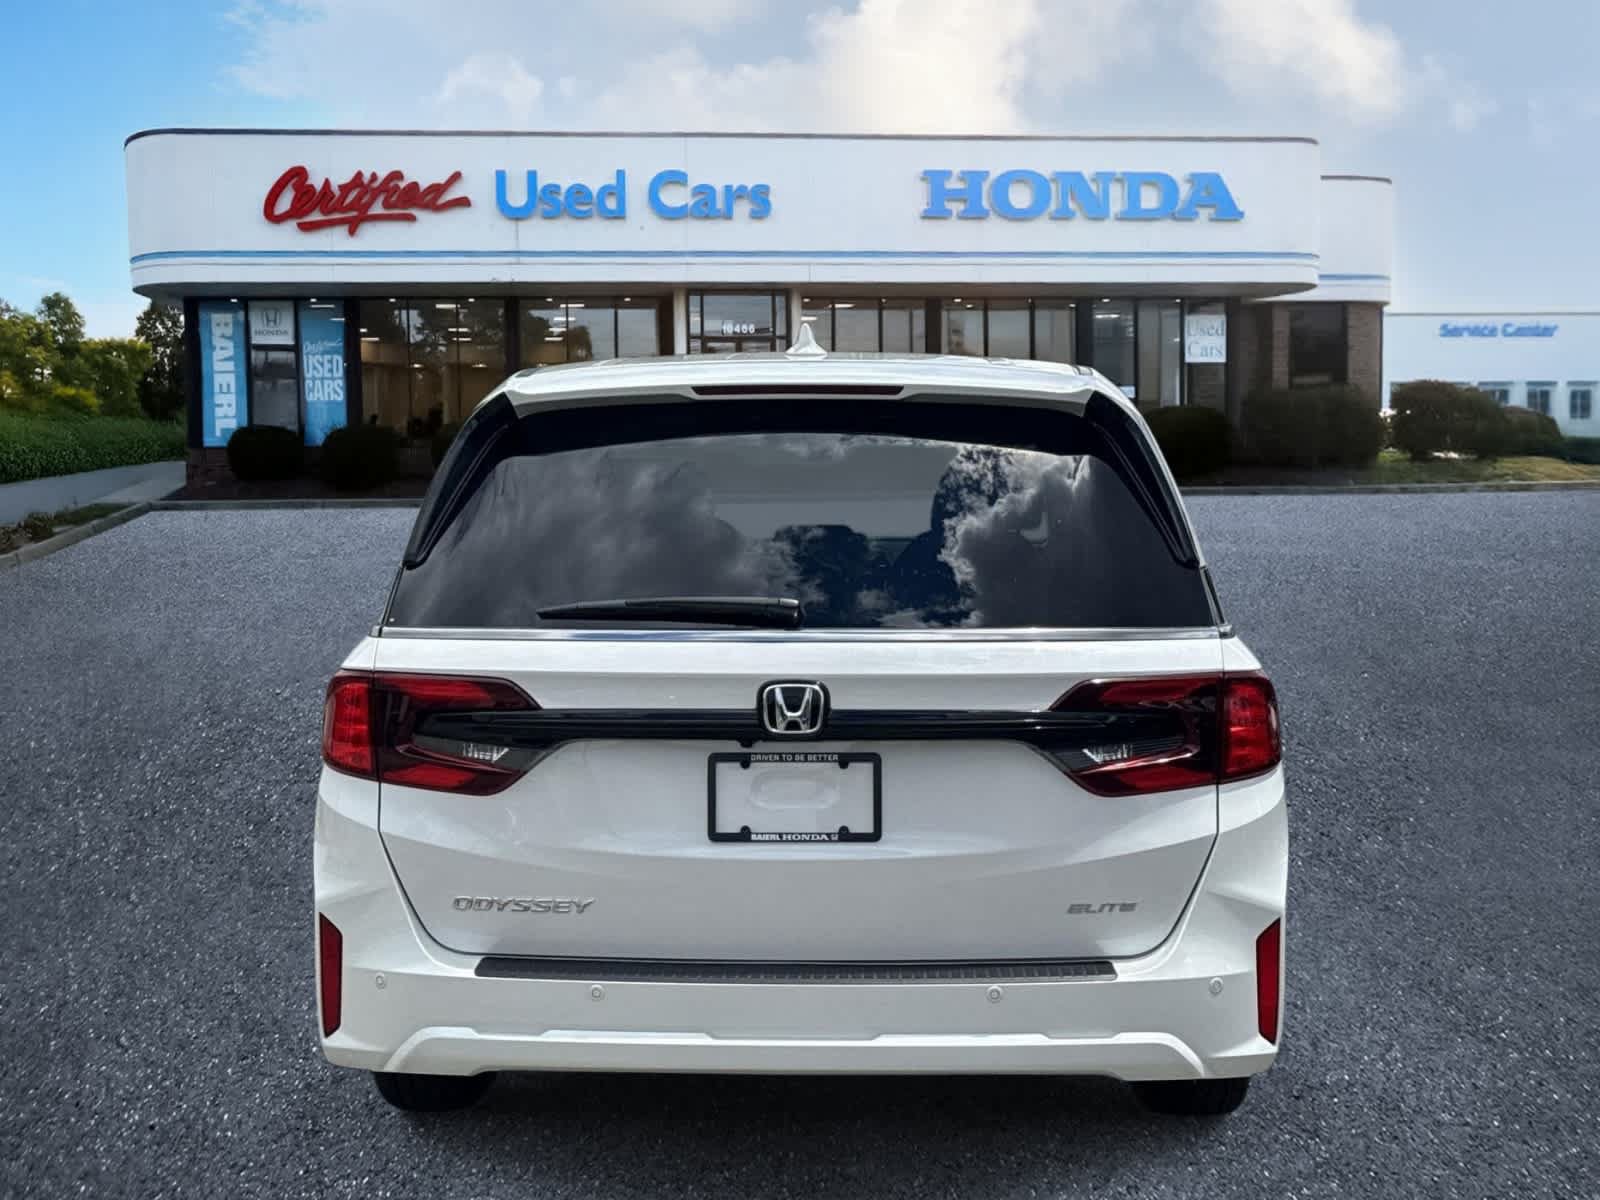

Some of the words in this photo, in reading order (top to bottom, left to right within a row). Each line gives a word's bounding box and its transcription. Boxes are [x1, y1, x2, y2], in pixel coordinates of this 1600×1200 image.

[263, 165, 472, 236] Certified
[495, 169, 627, 219] Used
[648, 169, 773, 219] Cars
[920, 169, 1245, 221] HONDA
[254, 328, 289, 337] HONDA
[1186, 319, 1225, 337] Used
[1439, 323, 1498, 337] Service
[1186, 341, 1224, 359] Cars
[211, 313, 237, 437] BAIERL
[303, 354, 343, 378] USED
[304, 379, 344, 402] CARS
[453, 895, 596, 914] ODYSSEY
[1066, 902, 1137, 915] ELITE
